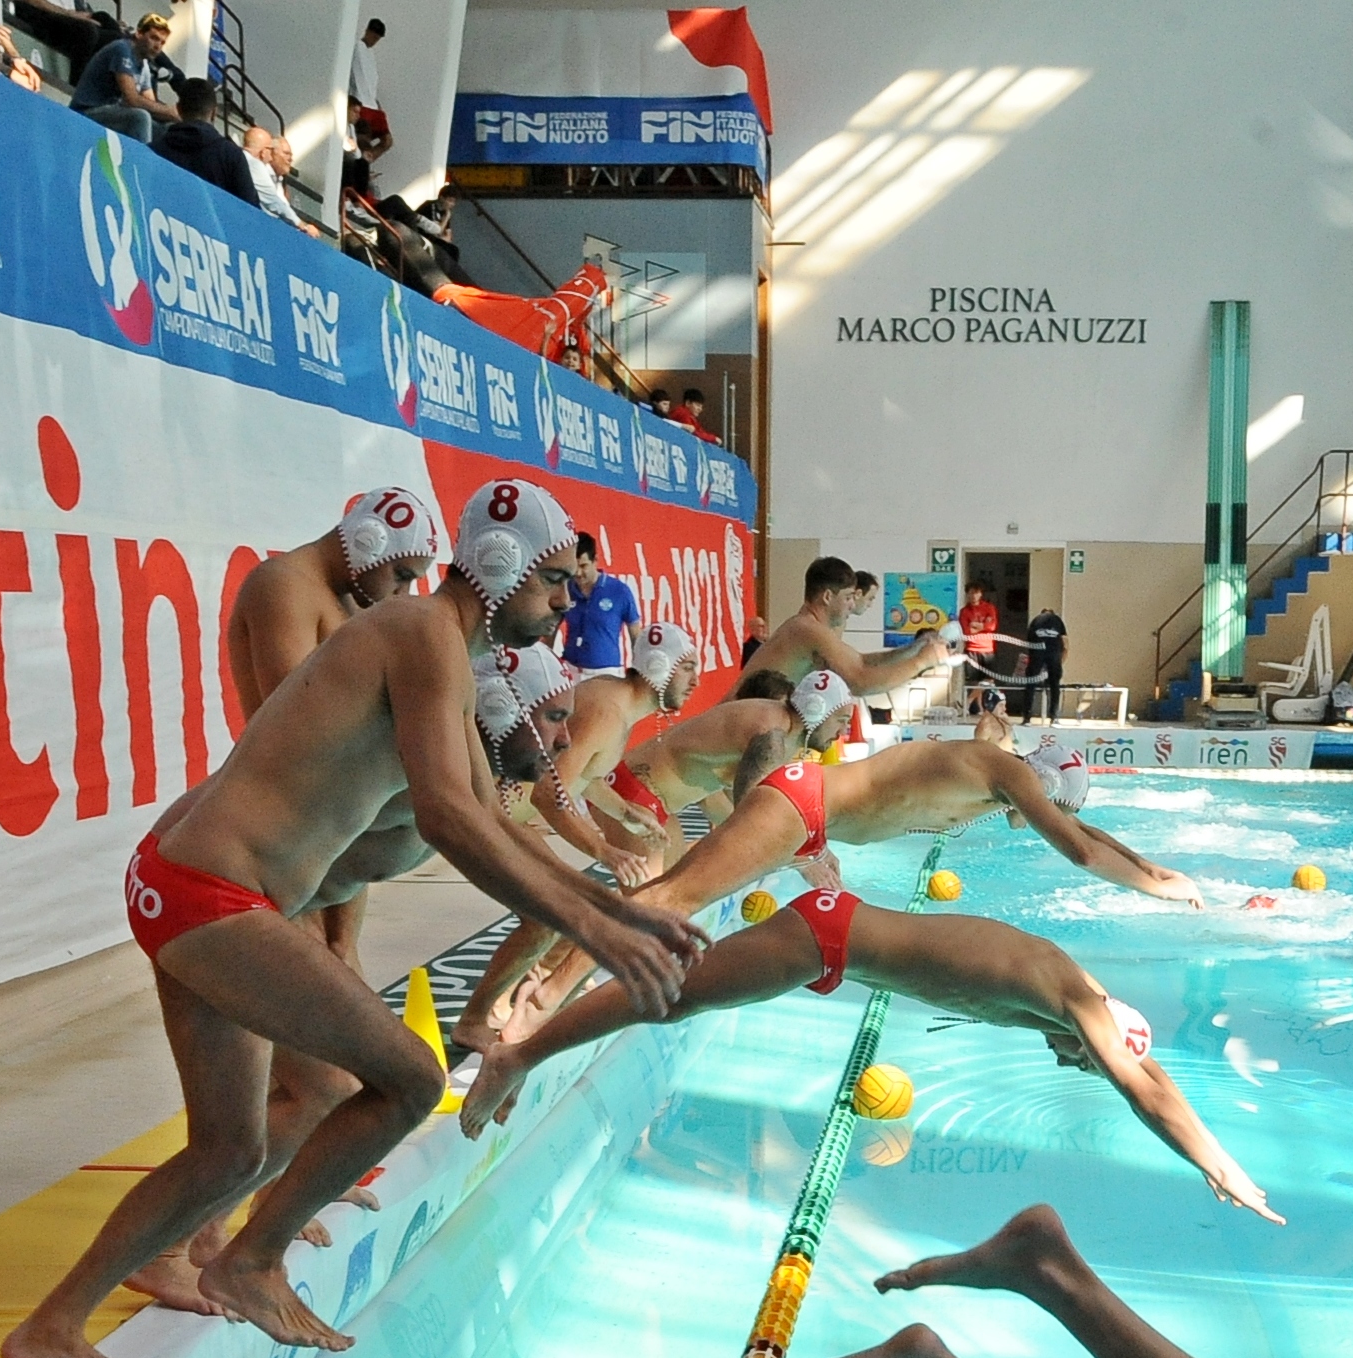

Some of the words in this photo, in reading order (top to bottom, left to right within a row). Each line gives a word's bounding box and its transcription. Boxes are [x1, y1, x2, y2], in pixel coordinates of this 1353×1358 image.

[475, 111, 546, 143] FIN
[549, 120, 608, 131] ITALIANA
[641, 111, 714, 143] FIN
[549, 131, 609, 143] NUOTO
[716, 130, 756, 145] NUOT
[149, 208, 243, 332] SERIE
[239, 250, 272, 342] A1
[930, 288, 1056, 312] PISCINA
[288, 274, 341, 367] FIN
[837, 317, 955, 343] MARCO
[964, 318, 1147, 343] PAGANUZZI
[416, 330, 464, 409] SERIE
[373, 491, 415, 528] 10
[488, 484, 520, 522] 8
[648, 625, 663, 646] 6
[814, 673, 829, 691] 3
[1041, 734, 1056, 744] SC
[1155, 734, 1172, 744] SC
[1271, 736, 1287, 746] SC
[1059, 752, 1082, 771] 7
[1086, 747, 1134, 765] iren
[1200, 747, 1248, 766] iren
[1126, 1028, 1148, 1056] 12
